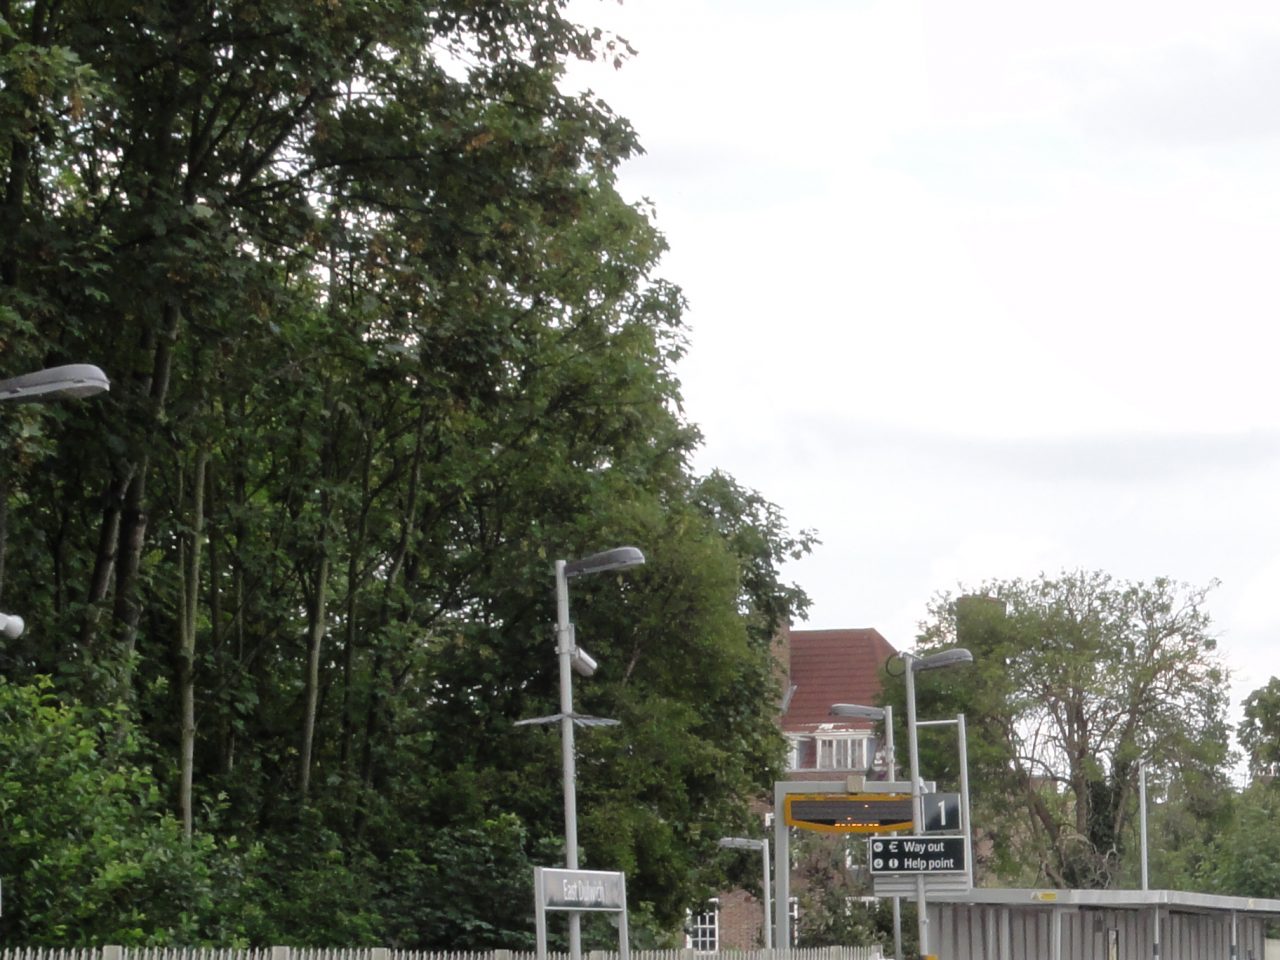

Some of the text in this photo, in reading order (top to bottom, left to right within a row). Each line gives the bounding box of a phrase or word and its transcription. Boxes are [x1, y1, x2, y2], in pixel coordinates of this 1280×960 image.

[938, 800, 946, 826] 1
[904, 841, 945, 854] Way out
[904, 858, 954, 871] Help point
